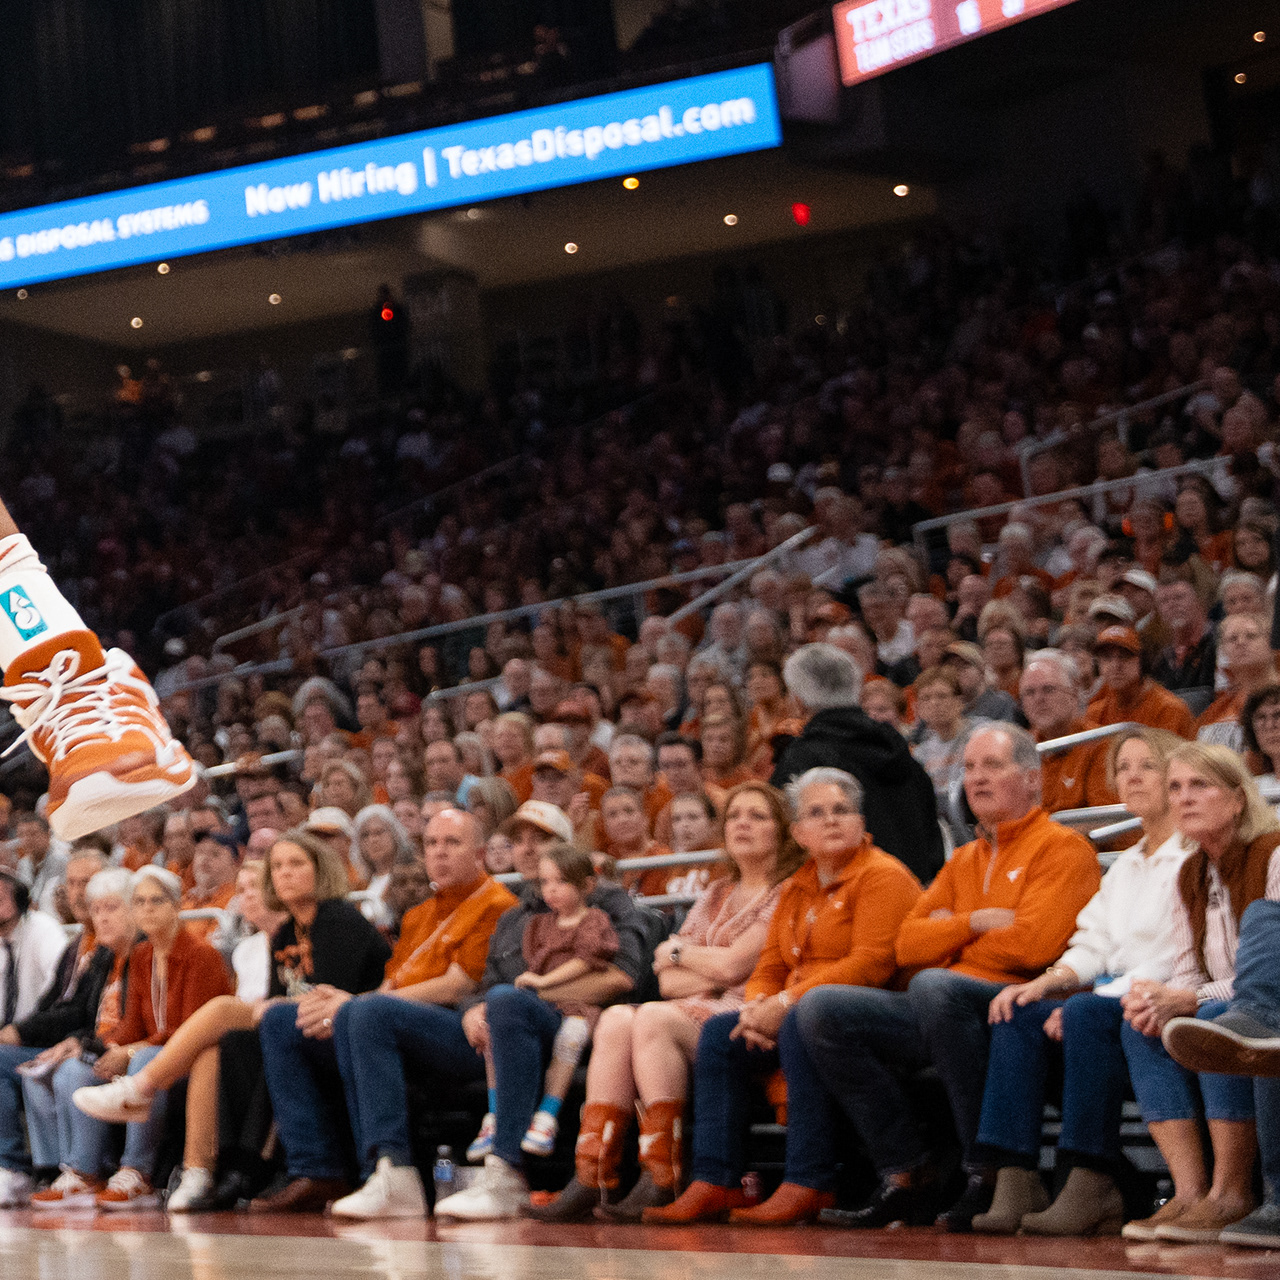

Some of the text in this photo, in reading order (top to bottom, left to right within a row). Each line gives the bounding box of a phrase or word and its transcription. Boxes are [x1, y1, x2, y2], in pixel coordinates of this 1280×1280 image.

[245, 181, 311, 217] Now
[318, 162, 417, 205] Hiring
[442, 96, 756, 179] TexasDisposal.com
[16, 218, 115, 258] DISPOSAL
[117, 199, 209, 239] SYSTEMS
